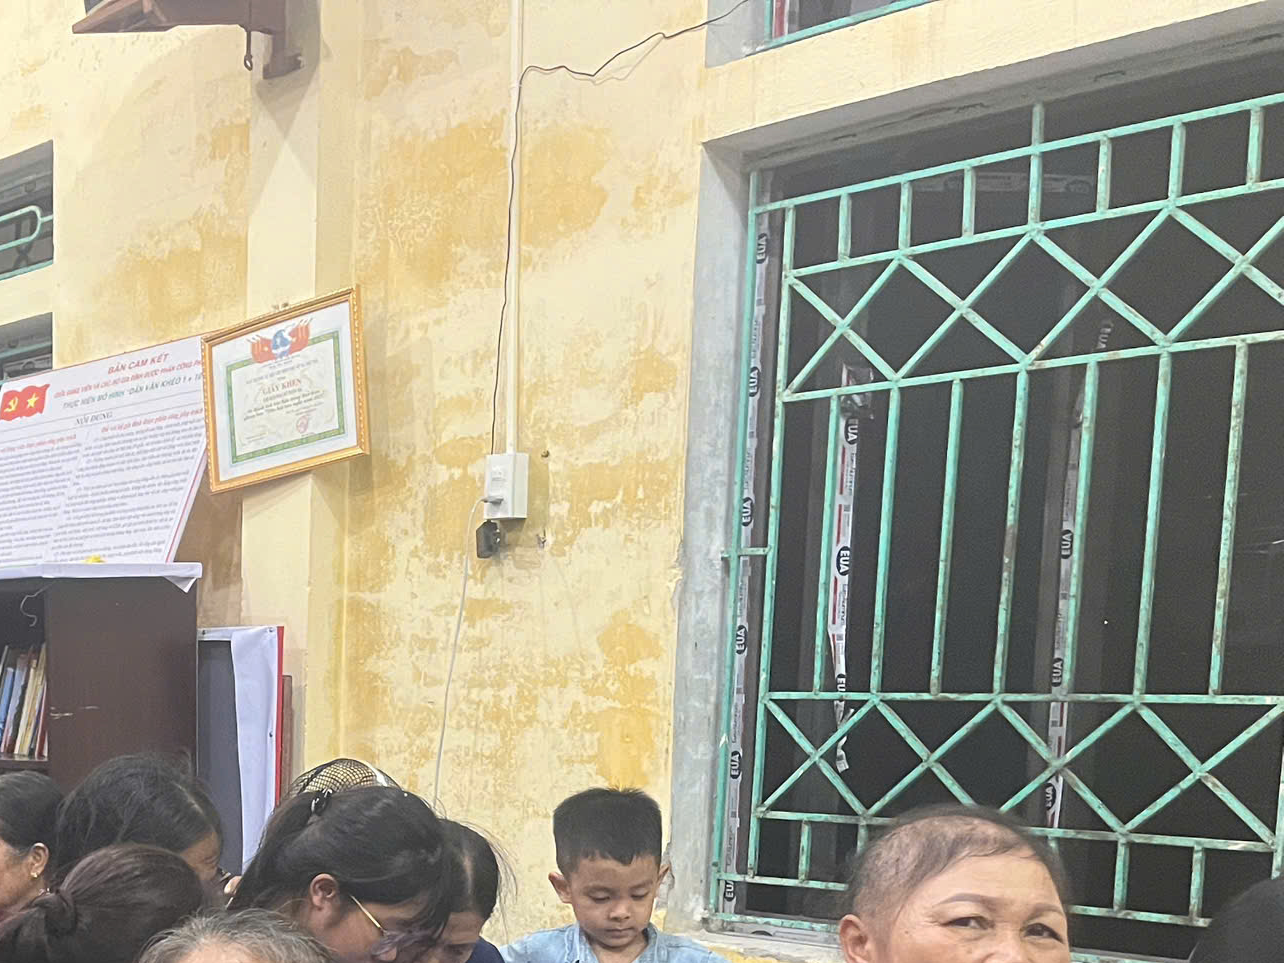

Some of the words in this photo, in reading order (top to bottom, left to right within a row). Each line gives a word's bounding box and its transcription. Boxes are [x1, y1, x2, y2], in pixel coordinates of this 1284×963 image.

[756, 237, 767, 261] EUA
[128, 357, 149, 370] CAM
[150, 351, 170, 365] KẾT
[749, 369, 759, 394] EUA
[742, 499, 752, 523] EUA
[1060, 532, 1073, 556] EUA
[839, 550, 850, 573] EUA
[736, 627, 746, 651] EUA
[1052, 660, 1064, 683] EUA
[731, 752, 740, 776] EUA
